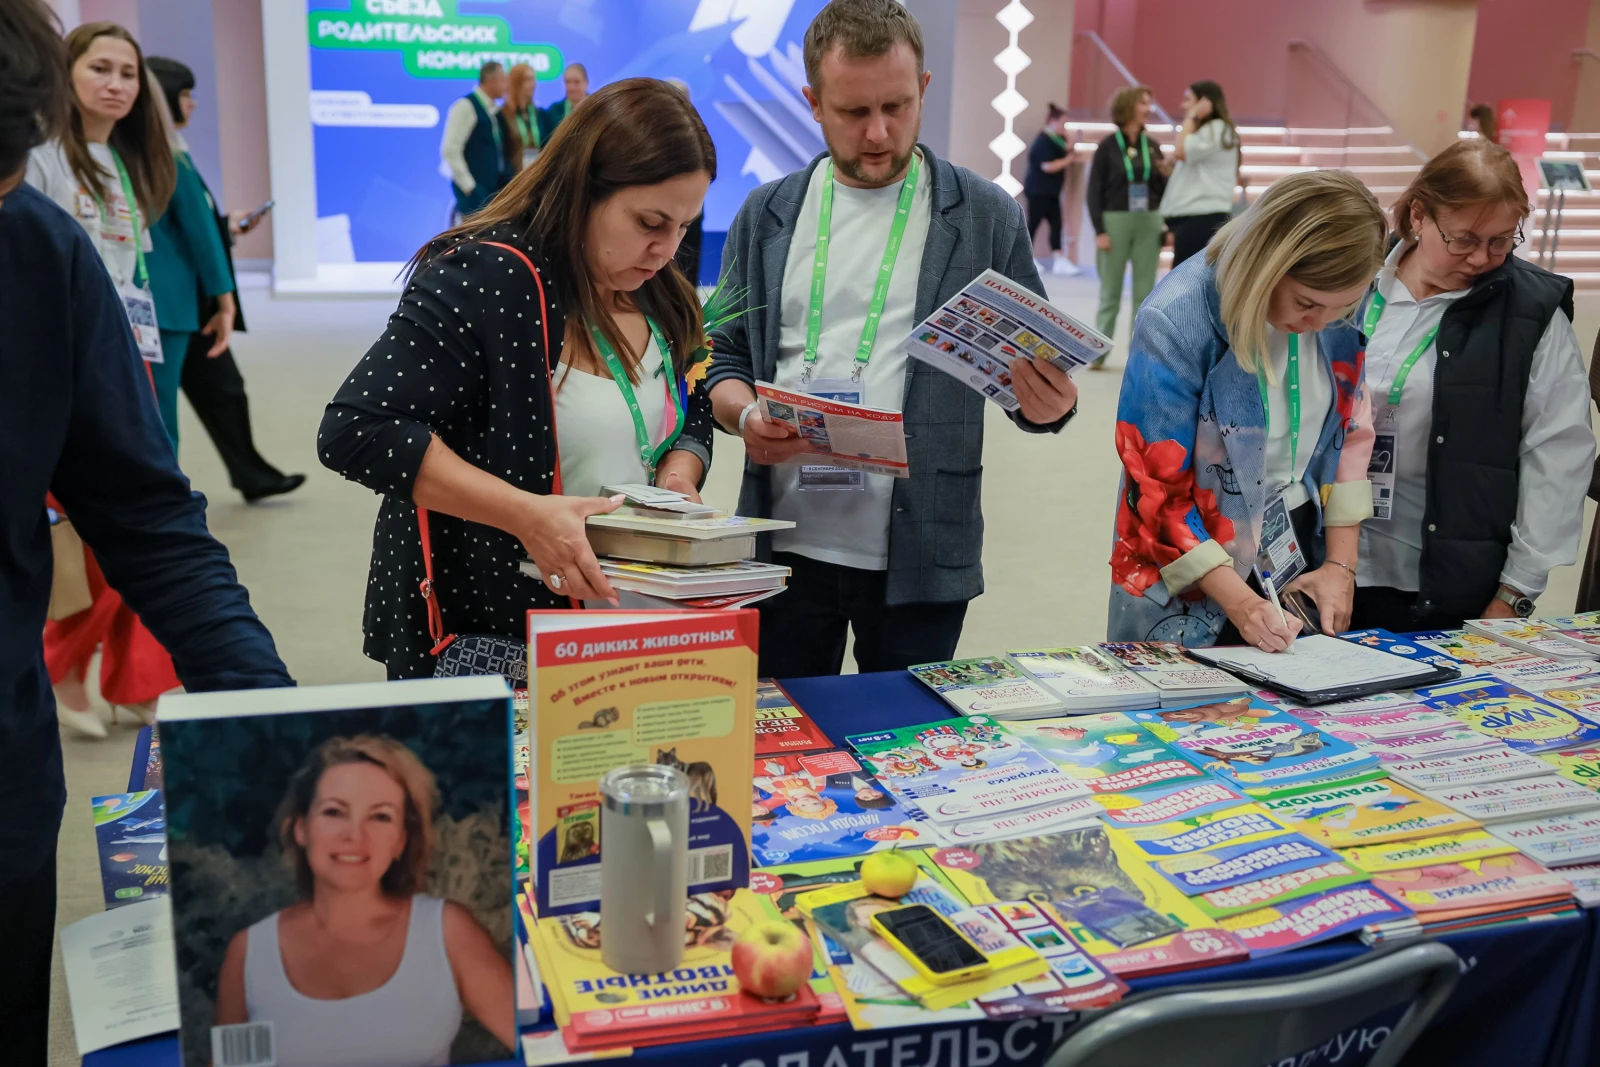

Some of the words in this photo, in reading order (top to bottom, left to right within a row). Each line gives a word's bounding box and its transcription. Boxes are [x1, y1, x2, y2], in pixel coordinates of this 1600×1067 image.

[318, 21, 498, 44] РОДИТЕЛЬСКИХ
[985, 279, 1037, 308] НАРОДЫ
[1038, 306, 1085, 341] РОССИИ
[779, 394, 798, 403] МЫ
[801, 400, 844, 414] РИСУЕМ
[866, 412, 895, 421] ХОДУ
[554, 642, 578, 659] 60
[581, 638, 638, 658] ДИКИХ
[642, 628, 736, 650] ЖИВОТНЫХ
[550, 689, 566, 704] Об
[568, 674, 596, 693] этом
[599, 663, 641, 680] узнают
[643, 658, 674, 670] ваши
[573, 684, 617, 706] Вместе
[629, 675, 668, 688] новым
[670, 671, 738, 689] открытиям!
[1480, 706, 1558, 729] МИР
[1174, 722, 1300, 749] ЖИВОТНЫЕ
[1227, 738, 1275, 750] ДИКИЕ
[1259, 756, 1331, 778] РАСКРАСКА
[1300, 756, 1355, 772] РЕЧЕВАЯ
[1391, 759, 1452, 772] ЗВУКИ
[1458, 751, 1517, 763] УЧИМ
[957, 766, 1017, 783] наклейками
[988, 767, 1060, 787] Раскраска
[1018, 777, 1069, 791] народов
[1098, 767, 1199, 791] МОРСКИЕ
[972, 787, 1017, 801] России
[979, 782, 1080, 808] ПРОМЫСЛЫ
[1263, 784, 1390, 810] ТРАНСПОРТ
[1443, 787, 1506, 801] ЗВУКИ
[1511, 781, 1574, 792] УЧИМ
[1110, 791, 1235, 823] ДОМАШНИЕ
[1119, 784, 1221, 816] ПИТОМЦЫ
[828, 814, 880, 829] НАРОДЫ
[992, 800, 1091, 830] ПРОМЫСЛЫ
[778, 822, 830, 840] РОССИИ
[1151, 814, 1262, 848] ПОЛЯНА
[1169, 821, 1276, 853] ЛЕСНАЯ
[1354, 816, 1428, 838] РАСКРАСКА
[1507, 825, 1578, 839] ЗВУКИ
[1183, 841, 1311, 881] ТРАНСПОРТ
[1432, 876, 1516, 900] РАСКРАСКА
[1235, 888, 1380, 939] ЖИВОТНЫЕ
[1292, 897, 1392, 937] ЛЕСНЫЕ
[1189, 937, 1224, 954] 60
[636, 980, 728, 1000] ДИКИЕ
